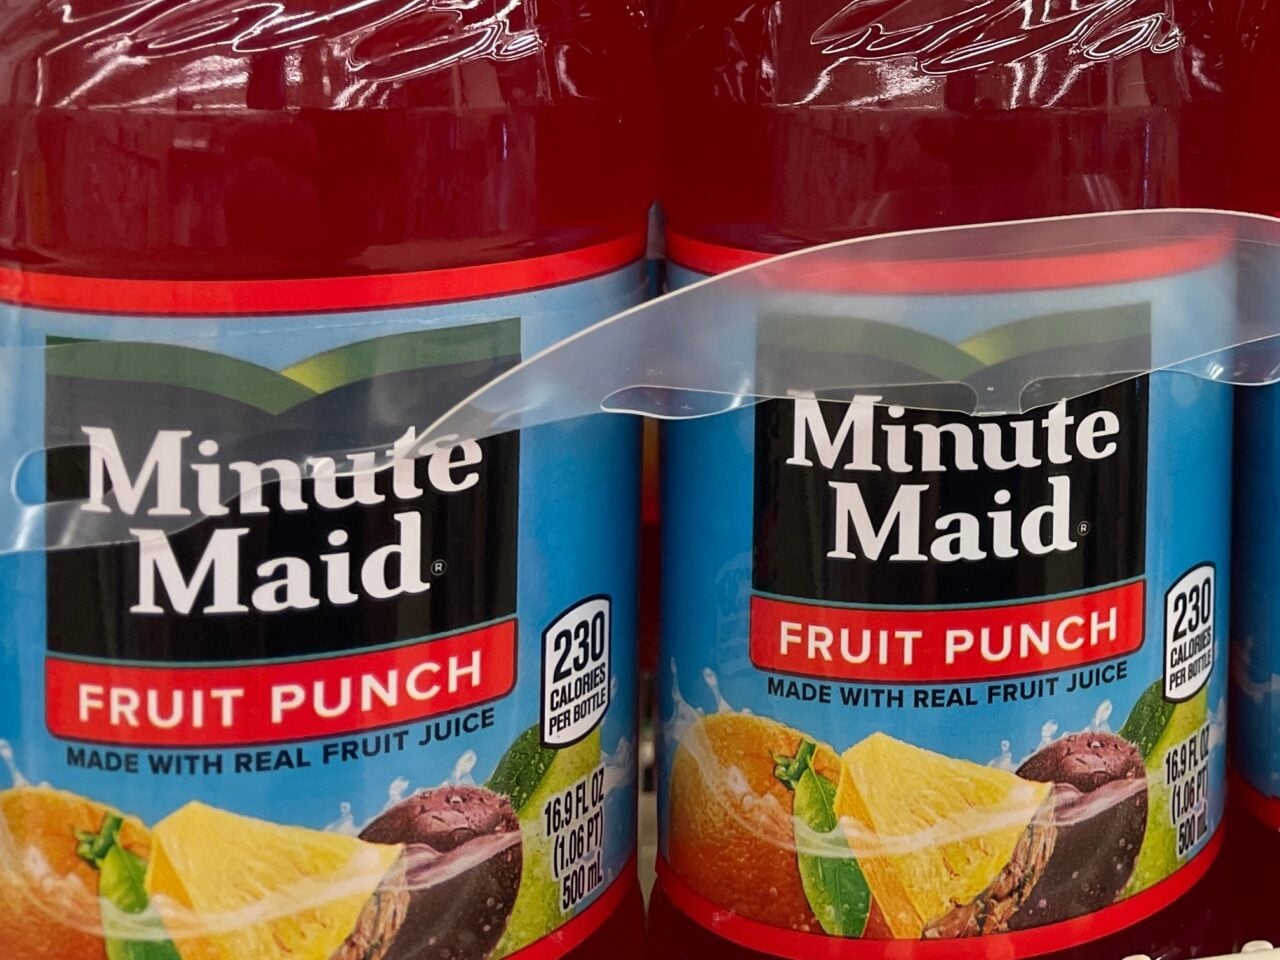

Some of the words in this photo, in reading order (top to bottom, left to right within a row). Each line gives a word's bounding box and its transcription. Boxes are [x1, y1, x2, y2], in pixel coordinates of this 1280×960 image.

[785, 389, 1121, 472] Minute
[81, 425, 483, 516] Minute
[827, 476, 1077, 562] Maid
[129, 512, 430, 614] Maid
[780, 622, 922, 665] FRUIT
[944, 607, 1117, 664] PUNCH
[1172, 577, 1211, 642] 230
[553, 611, 605, 683] 230
[1169, 669, 1186, 692] PER
[1188, 649, 1211, 683] BOTTLE
[1170, 626, 1211, 669] CALORIES
[78, 684, 244, 729] FRUIT
[271, 651, 482, 725] PUNCH
[549, 708, 571, 736] PER
[573, 689, 606, 723] BOTTLE
[550, 663, 605, 711] CALORIES
[768, 679, 832, 704] MADE
[840, 688, 904, 708] WITH
[914, 685, 978, 707] REAL
[987, 678, 1059, 704] FRUIT
[1066, 661, 1128, 693] JUICE
[67, 747, 138, 774] MADE
[148, 753, 222, 775] WITH
[235, 748, 311, 774] REAL
[323, 731, 406, 765] FRUIT
[418, 708, 495, 745] JUICE
[1166, 744, 1187, 786] 16.9
[1188, 737, 1198, 767] FL
[1199, 725, 1210, 760] OZ
[545, 789, 573, 836] 16.9
[575, 780, 589, 817] FL
[591, 767, 605, 803] OZ
[1171, 779, 1195, 824] (1.06
[1196, 760, 1208, 803] PT)
[553, 829, 584, 878] (1.06
[586, 809, 604, 848] PT)
[1178, 819, 1195, 855] 500
[563, 871, 586, 910] 500
[588, 854, 603, 888] mL
